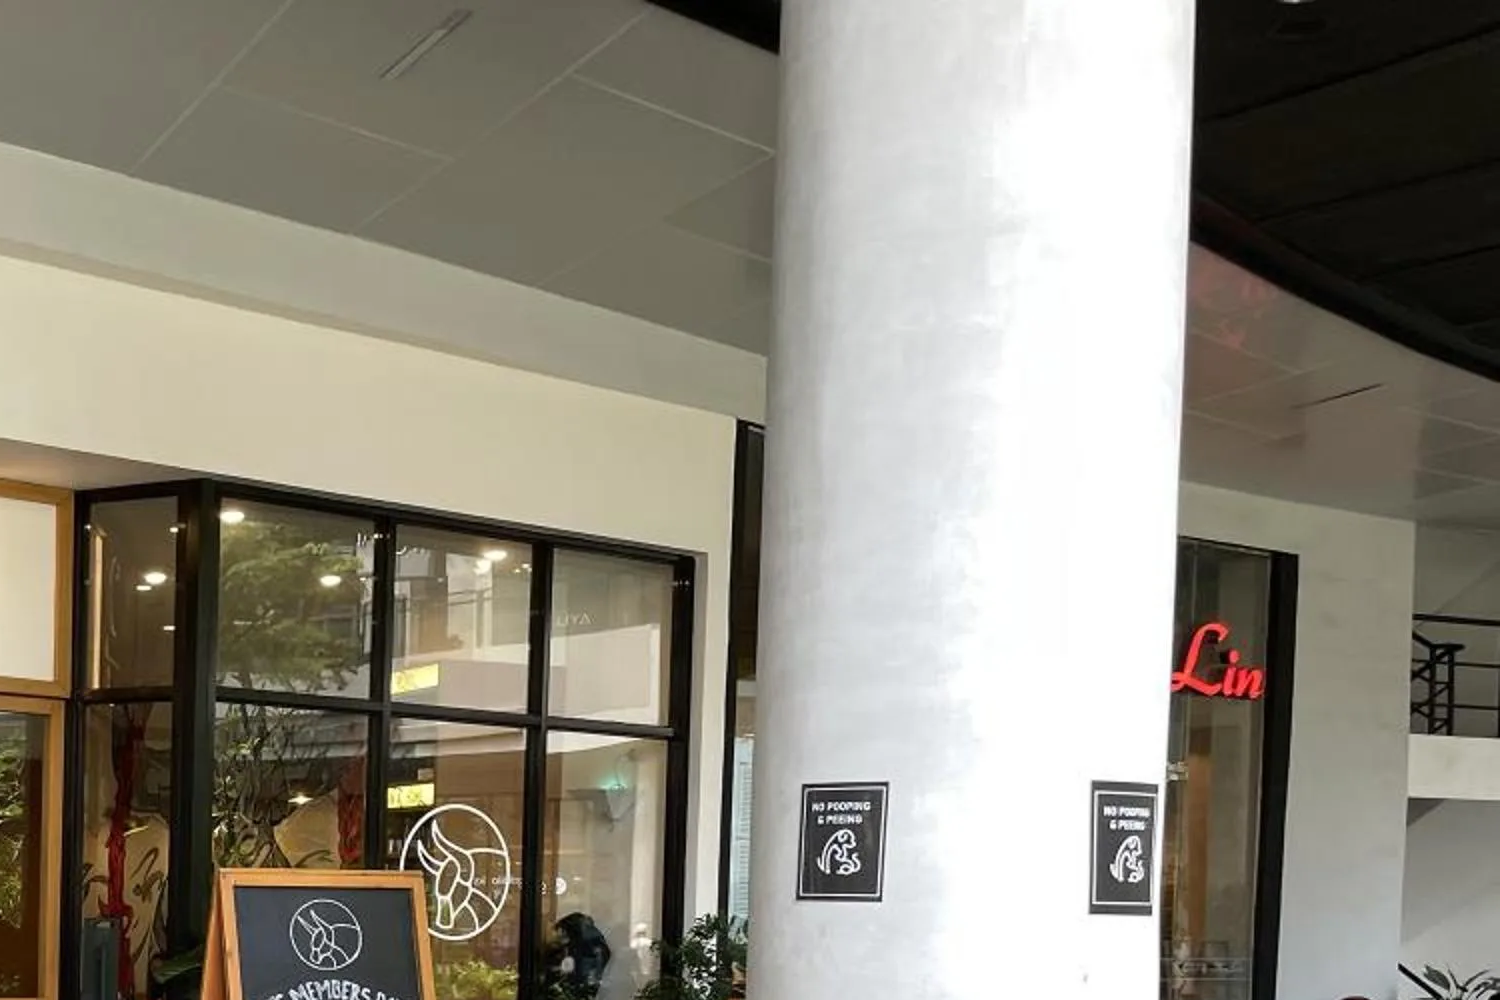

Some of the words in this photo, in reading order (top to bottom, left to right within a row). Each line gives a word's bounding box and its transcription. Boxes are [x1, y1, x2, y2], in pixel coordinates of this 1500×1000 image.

[1171, 622, 1265, 699] Lin
[811, 802, 825, 812] NO
[827, 801, 871, 811] POOPING
[1103, 805, 1117, 817] NO
[826, 815, 863, 825] PEEING
